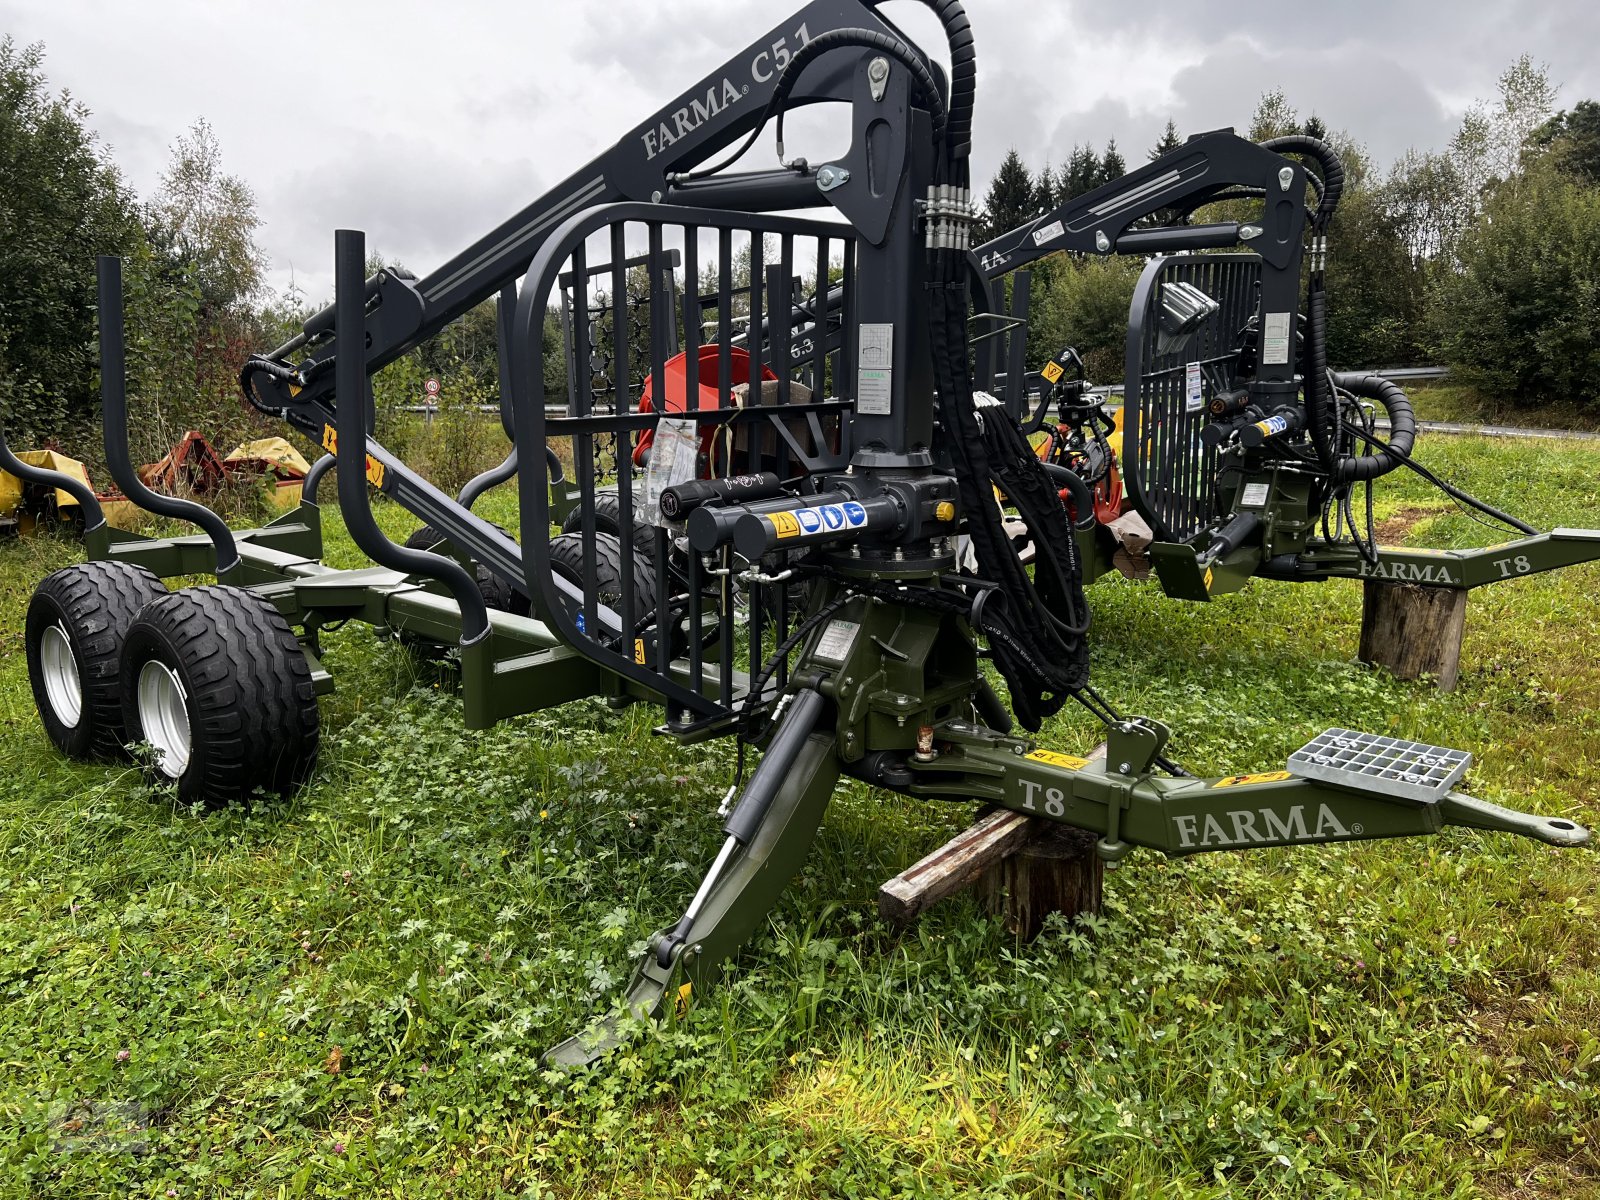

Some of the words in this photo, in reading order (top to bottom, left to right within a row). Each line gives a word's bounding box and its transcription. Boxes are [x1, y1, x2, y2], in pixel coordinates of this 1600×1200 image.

[751, 22, 811, 83] C5.1
[1493, 555, 1531, 578] T8
[1018, 778, 1065, 817] T8
